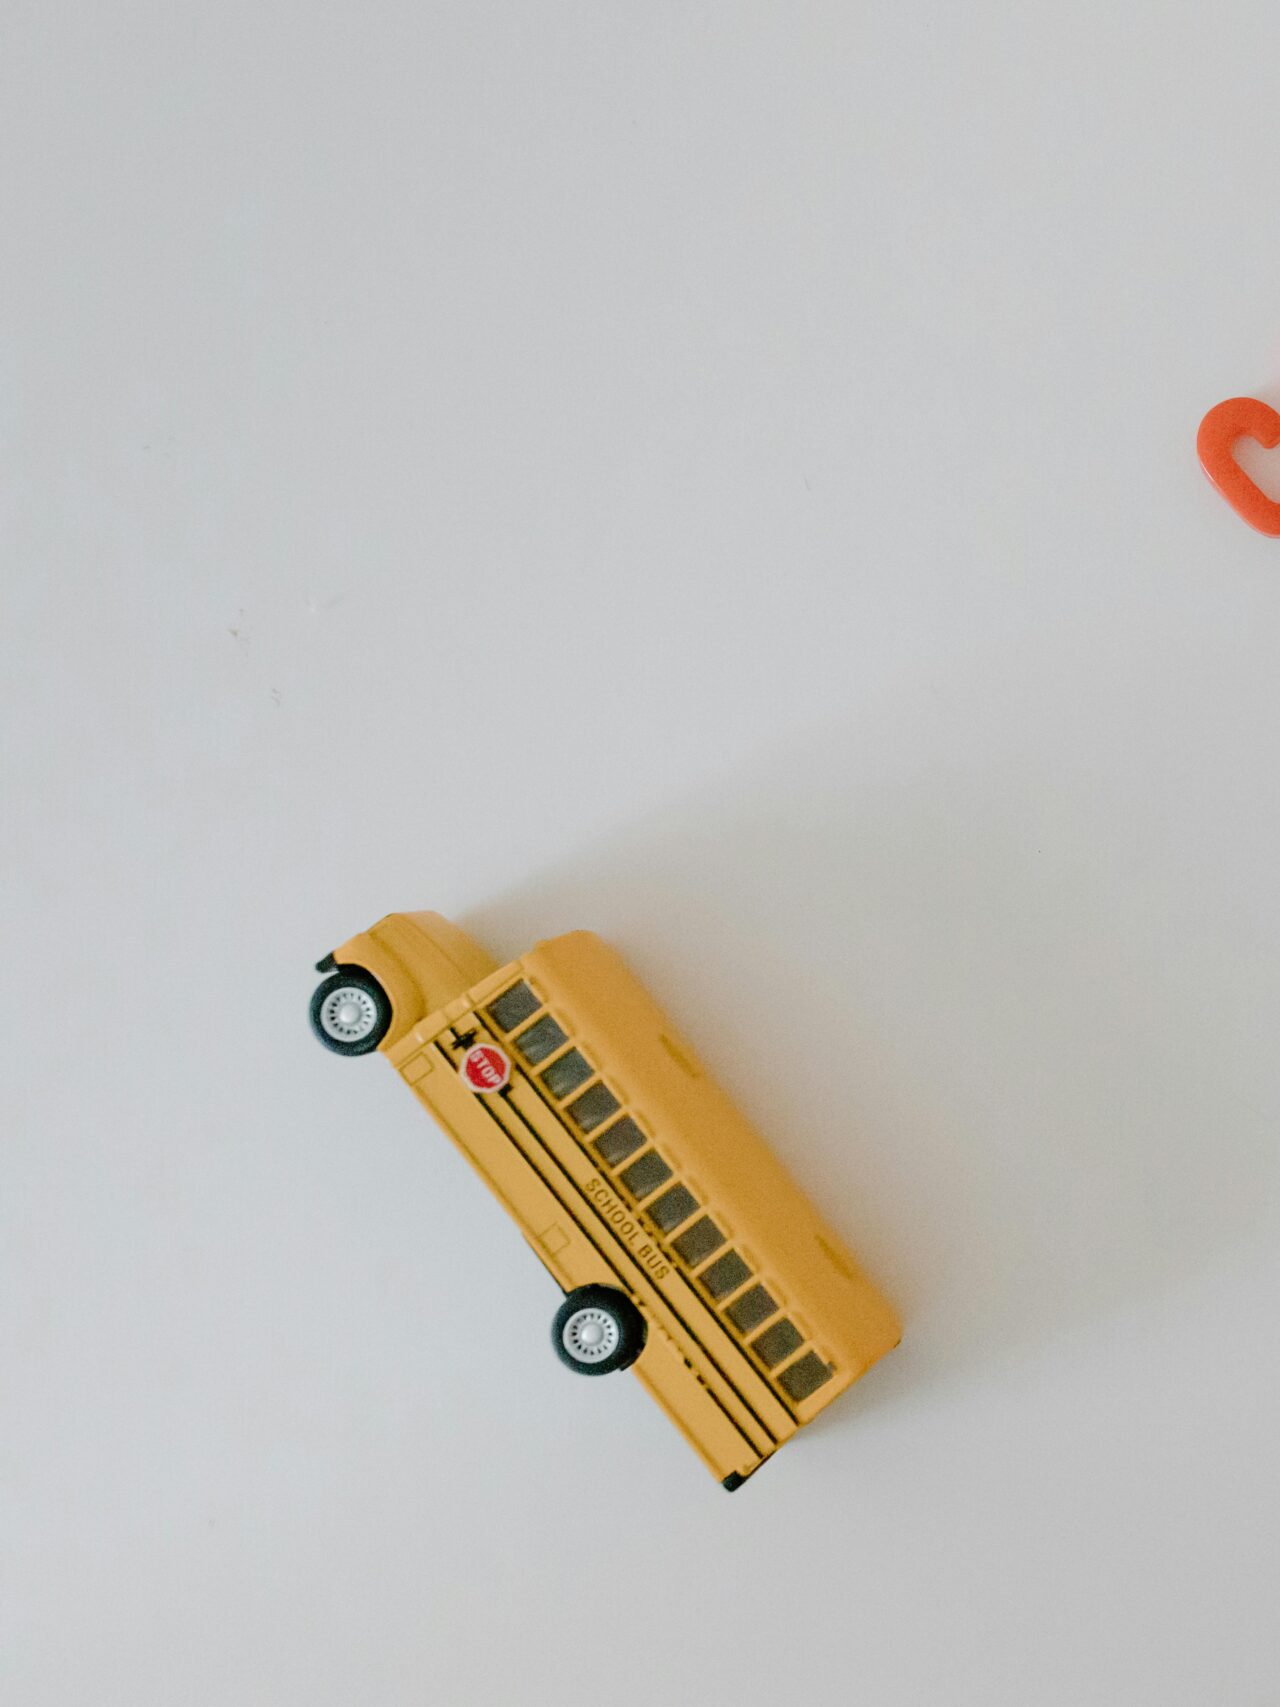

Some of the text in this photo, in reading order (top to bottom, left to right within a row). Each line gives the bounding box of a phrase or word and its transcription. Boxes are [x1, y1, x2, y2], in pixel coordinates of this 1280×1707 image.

[469, 1049, 501, 1085] STOP
[584, 1178, 670, 1280] SCHOOL BUS
